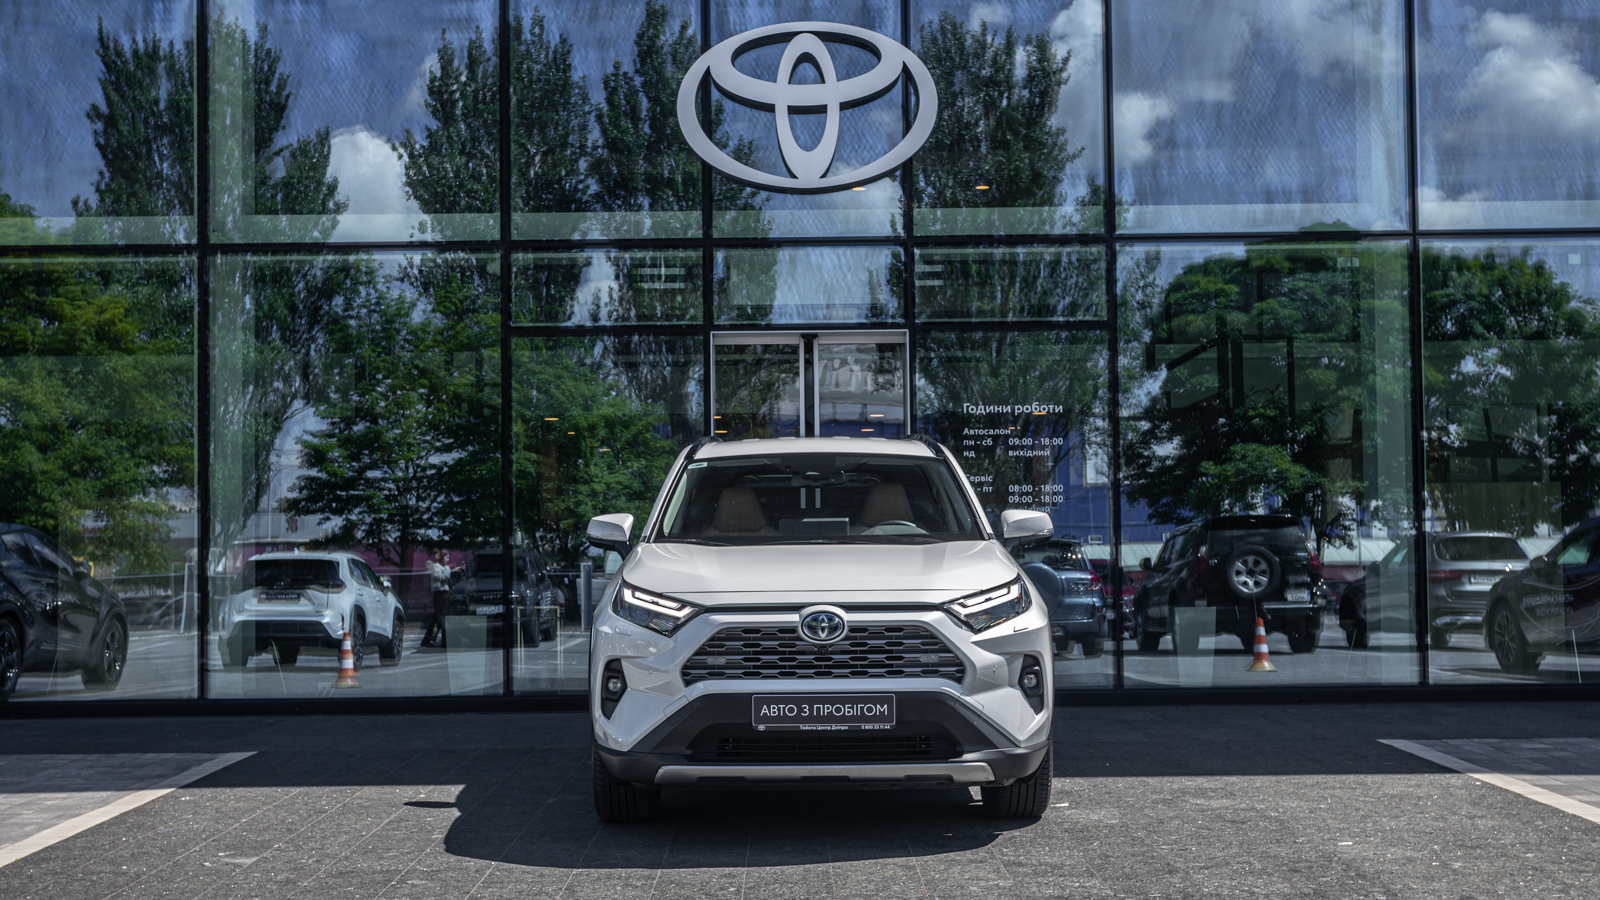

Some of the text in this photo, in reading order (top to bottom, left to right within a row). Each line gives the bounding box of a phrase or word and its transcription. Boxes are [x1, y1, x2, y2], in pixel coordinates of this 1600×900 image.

[963, 402, 1063, 415] Години роботи
[963, 427, 1011, 435] Автосалон
[1008, 437, 1033, 446] 09:00
[1040, 437, 1064, 446] 18:00
[963, 448, 1050, 458] нд вихідний
[760, 704, 888, 716] АВТО З ПРОБІГОМ
